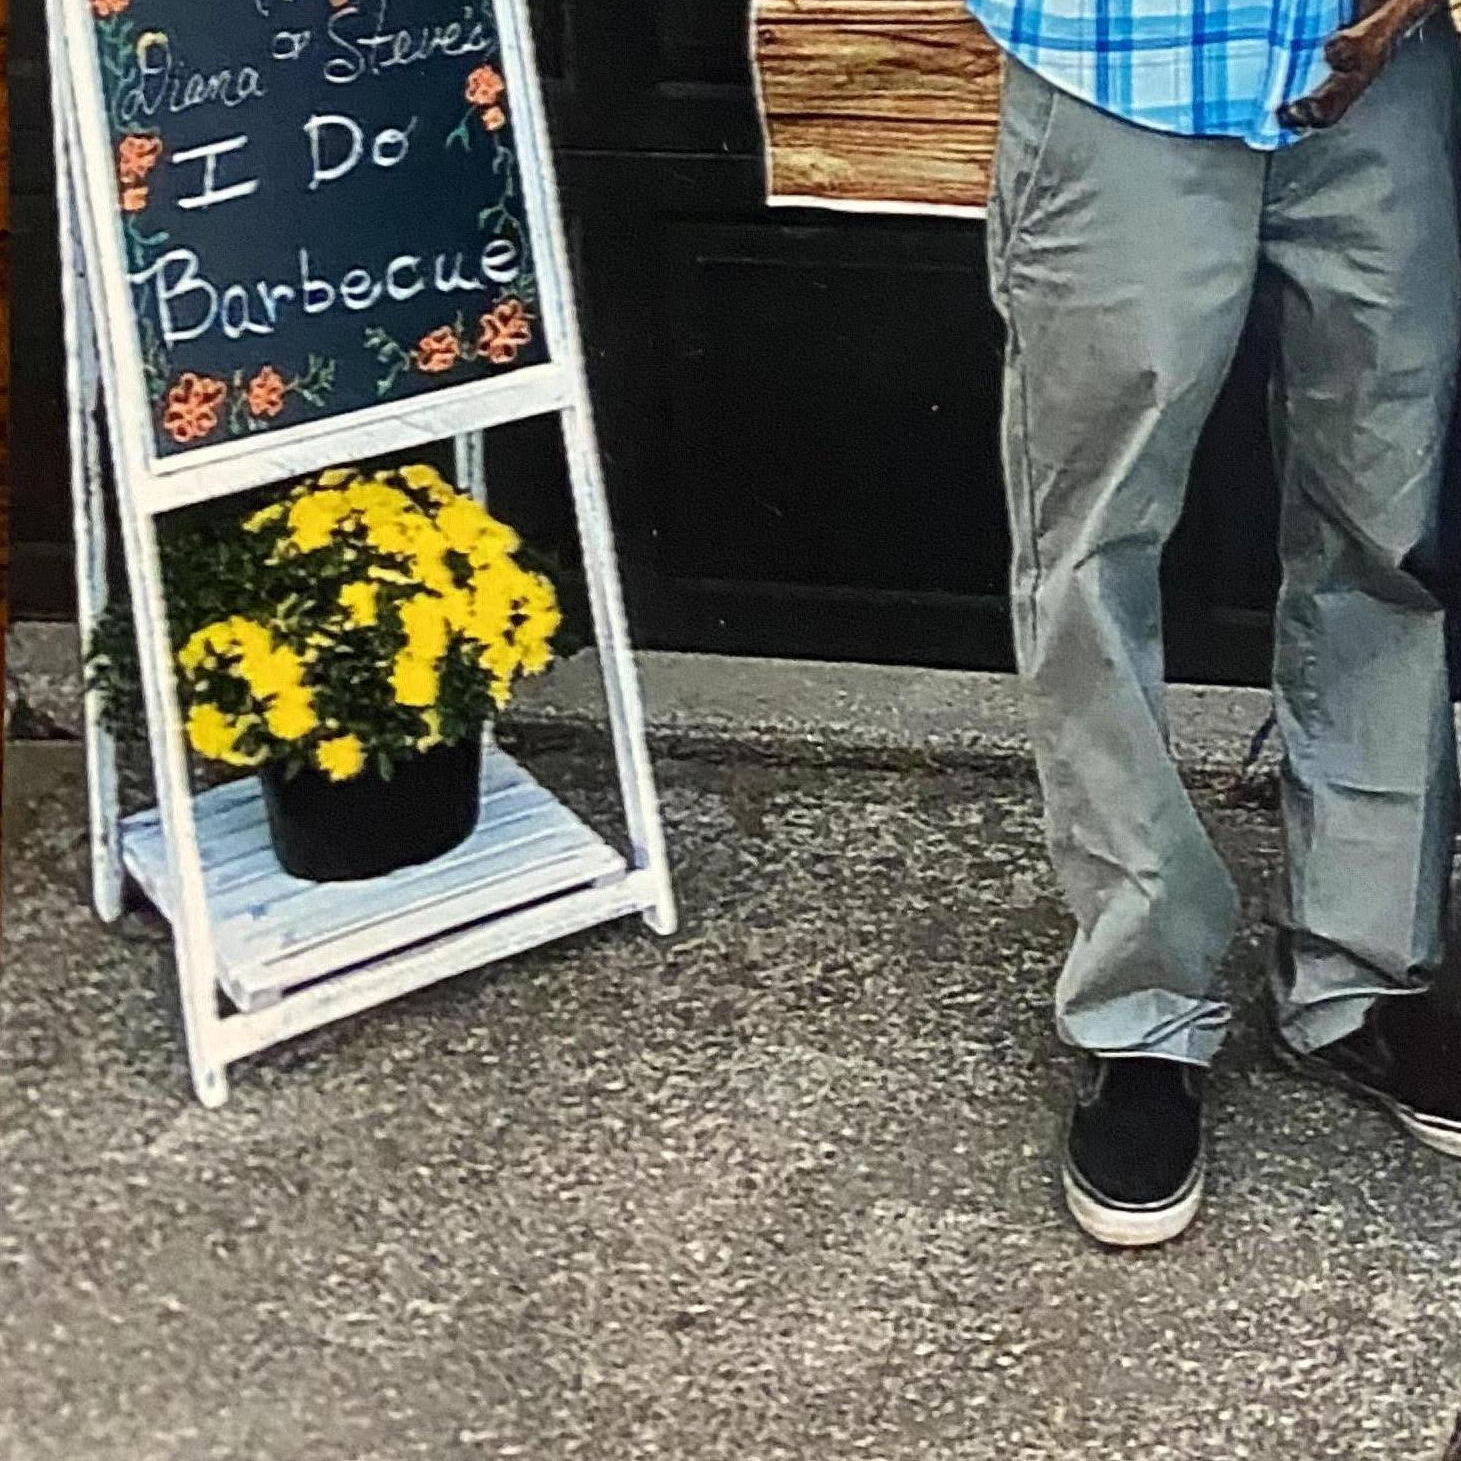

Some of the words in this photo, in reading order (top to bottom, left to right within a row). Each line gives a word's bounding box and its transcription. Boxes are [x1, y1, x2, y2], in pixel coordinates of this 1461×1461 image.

[116, 32, 265, 122] Diana
[171, 134, 259, 209] I
[303, 113, 420, 191] Do
[128, 238, 522, 350] Barbecue
